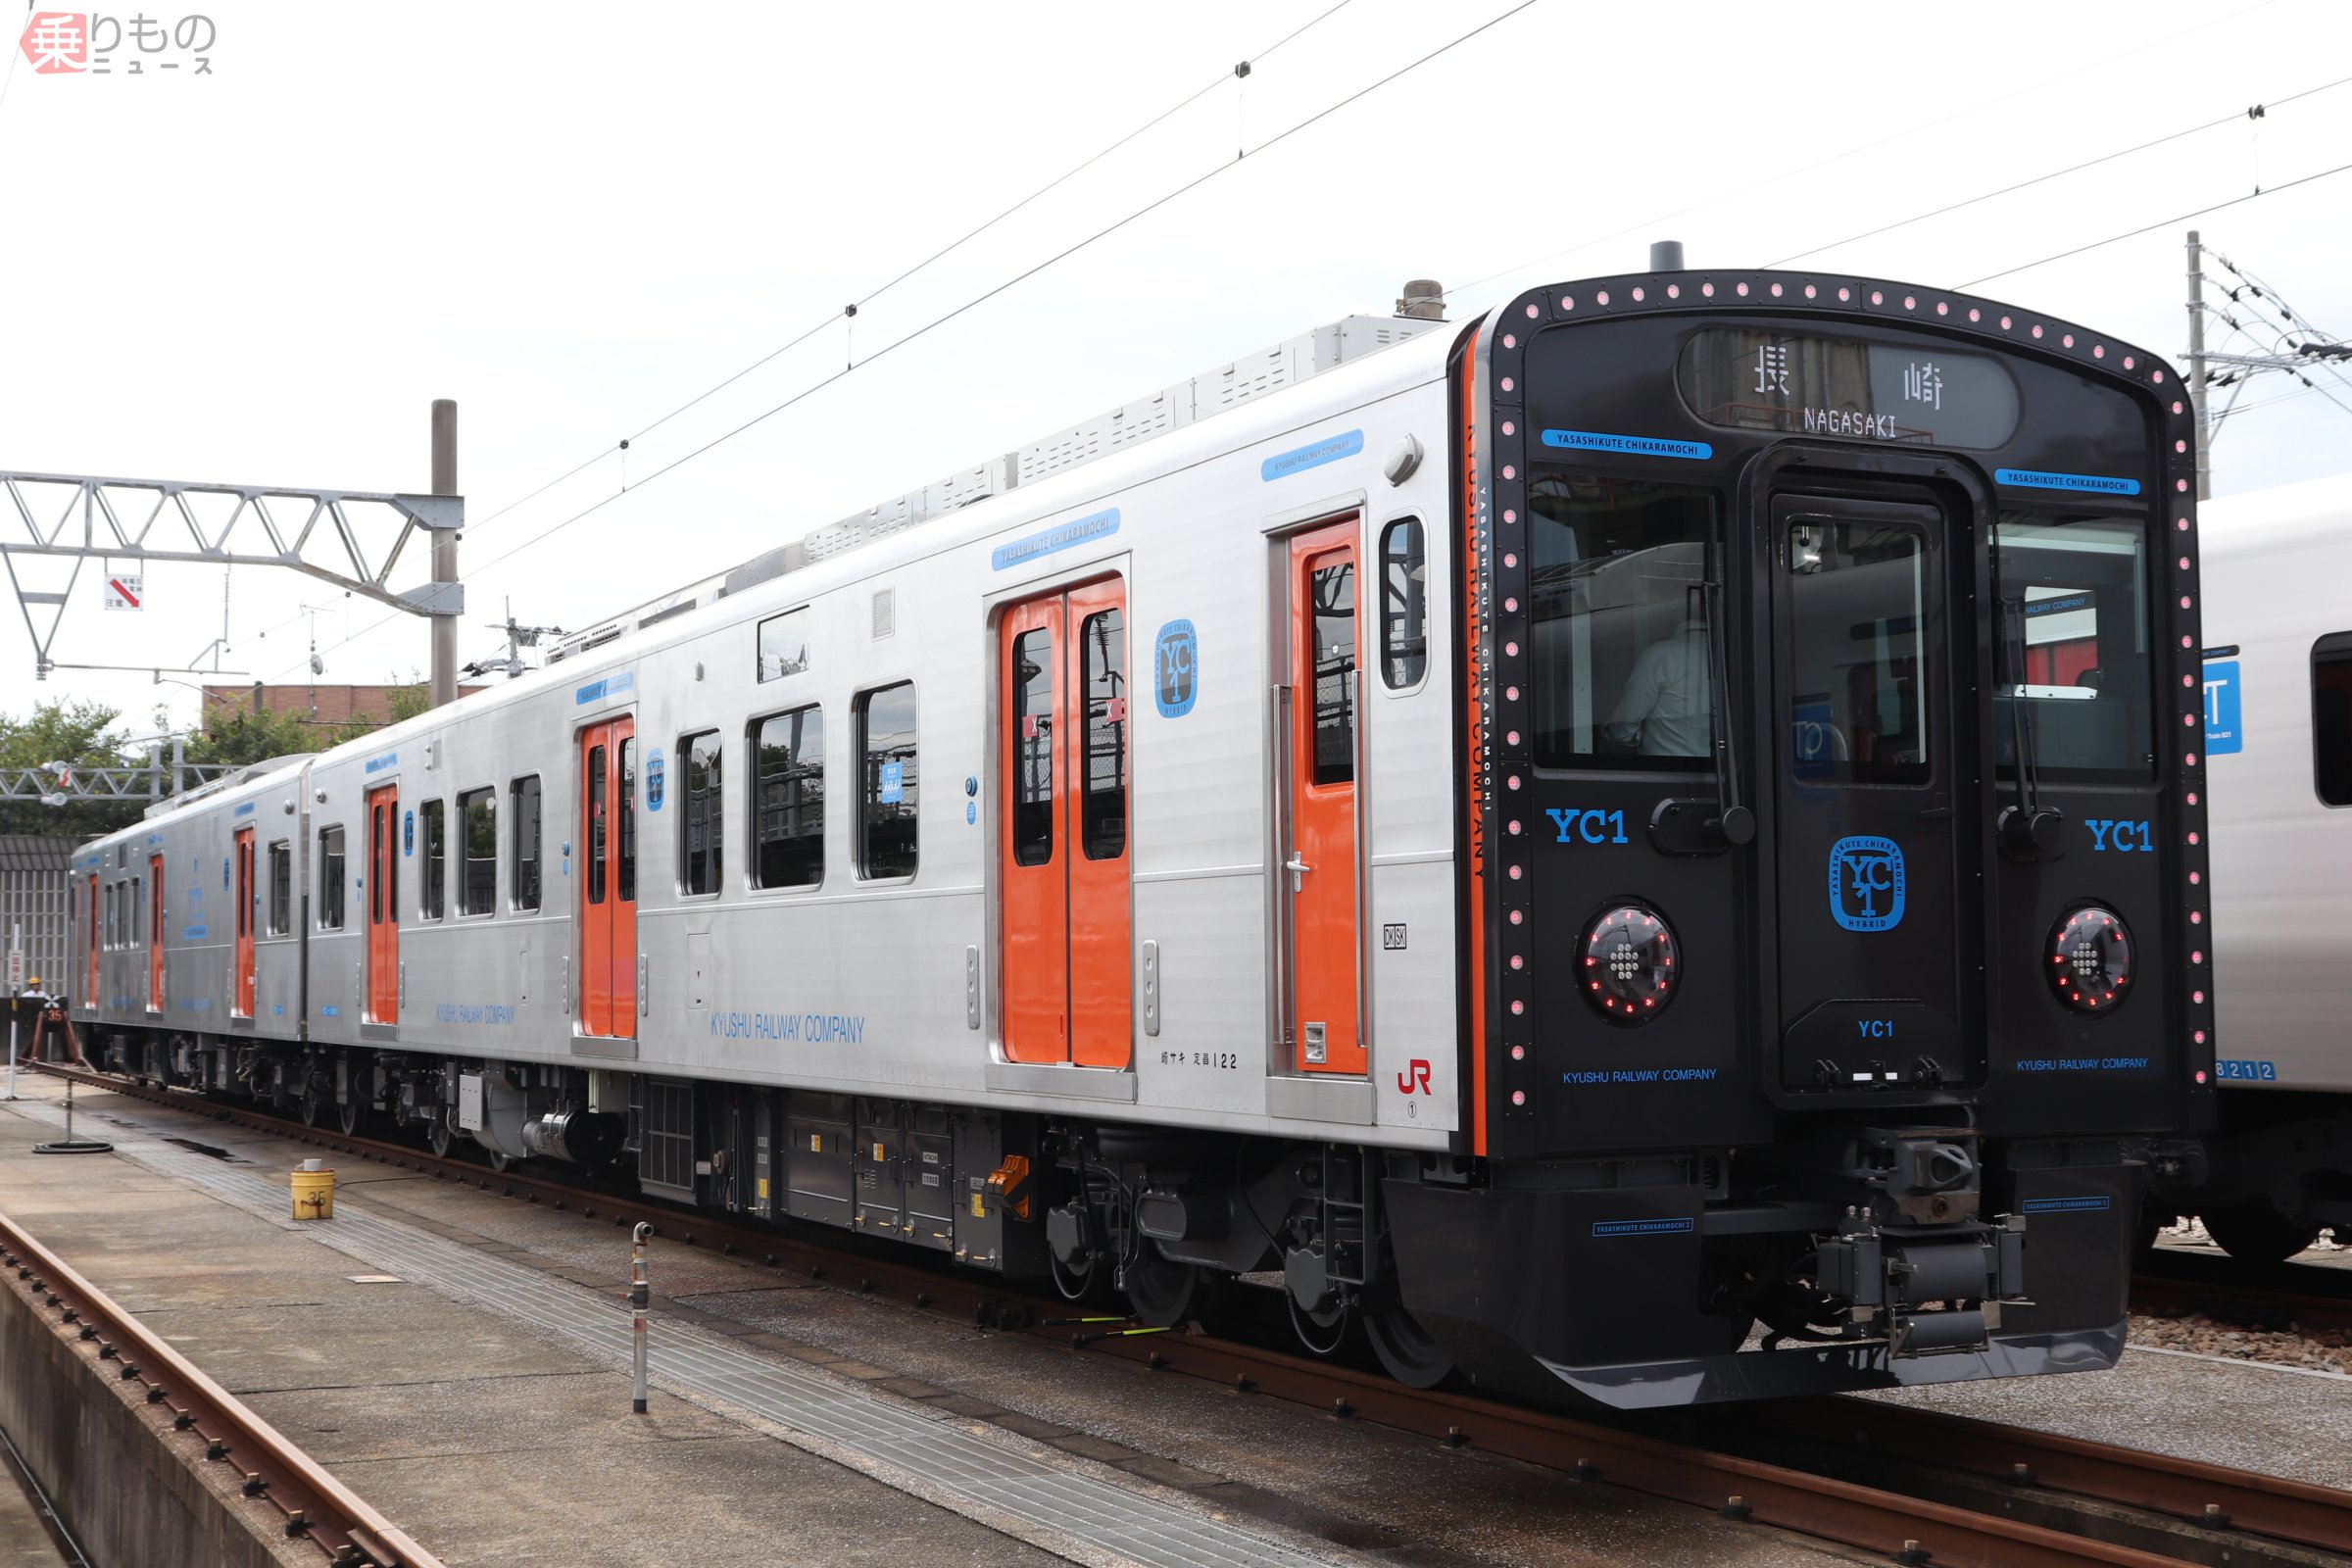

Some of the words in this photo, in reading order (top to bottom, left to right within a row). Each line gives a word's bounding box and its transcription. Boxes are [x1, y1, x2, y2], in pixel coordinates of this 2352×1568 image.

[1754, 346, 1789, 396] 長
[1904, 363, 1943, 411] 崎
[1804, 408, 1896, 438] NAGASAKI
[1275, 458, 1297, 471] KYUSHU
[1297, 450, 1321, 464] RAILWAY
[1321, 440, 1349, 457] COMPANY
[1557, 434, 1622, 449] YASASHIKUTE
[1625, 441, 1698, 455] CHIKARAMOCHI
[2008, 472, 2064, 486] YASASHIKUTE
[2066, 477, 2129, 491] CHIKARAMOCHI
[1002, 537, 1049, 564] YASASHIKUTE
[1050, 516, 1109, 547] CHIKARAMOCHI
[1480, 487, 1489, 632] YASASHIKUTE
[2053, 598, 2085, 610] COMPANY
[1482, 648, 1491, 811] CHIKARAMOCHI
[1472, 722, 1484, 878] COMPANY
[1545, 808, 1628, 844] YC1
[2084, 819, 2153, 852] YC1
[1833, 840, 1861, 896] YASASHIKUTE
[1865, 840, 1903, 897] CHIKARAMOCHI
[1848, 919, 1886, 928] HYBRID
[710, 1011, 752, 1039] KYUSHU
[756, 1013, 801, 1041] RAILWAY
[805, 1014, 864, 1044] COMPANY
[1858, 1020, 1893, 1038] YC1
[1397, 1059, 1432, 1096] JR
[1563, 1071, 1609, 1084] KYUSHU
[1612, 1070, 1659, 1082] RAILWAY
[1663, 1068, 1717, 1081] COMPANY
[2017, 1059, 2056, 1071] KYUSHU
[2059, 1058, 2099, 1070] RAILWAY
[2101, 1057, 2148, 1069] COMPANY
[1640, 1222, 1685, 1231] CHIKARAMOCHI
